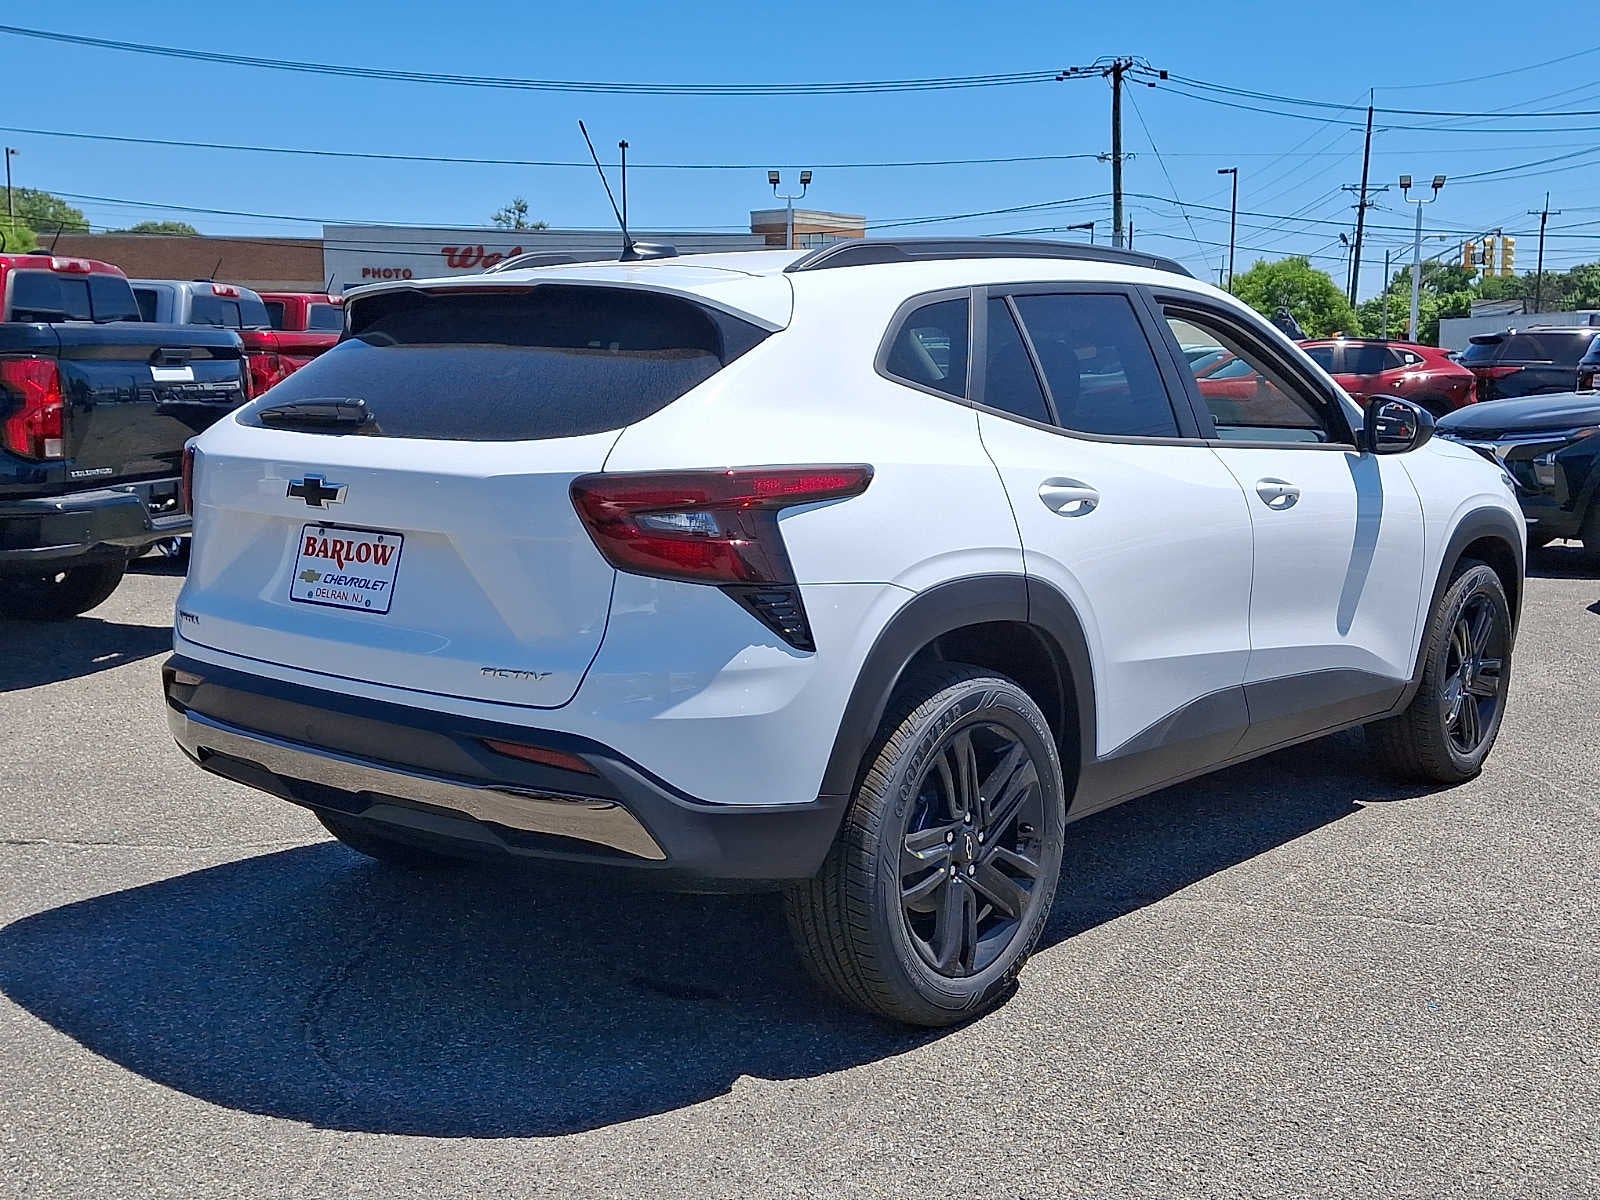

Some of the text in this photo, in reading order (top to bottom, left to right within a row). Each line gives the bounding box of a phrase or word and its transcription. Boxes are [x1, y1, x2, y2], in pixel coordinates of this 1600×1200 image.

[362, 267, 412, 279] PHOTO
[303, 536, 396, 571] BARLOW
[323, 573, 388, 592] CHEVROLET
[352, 594, 363, 603] NJ
